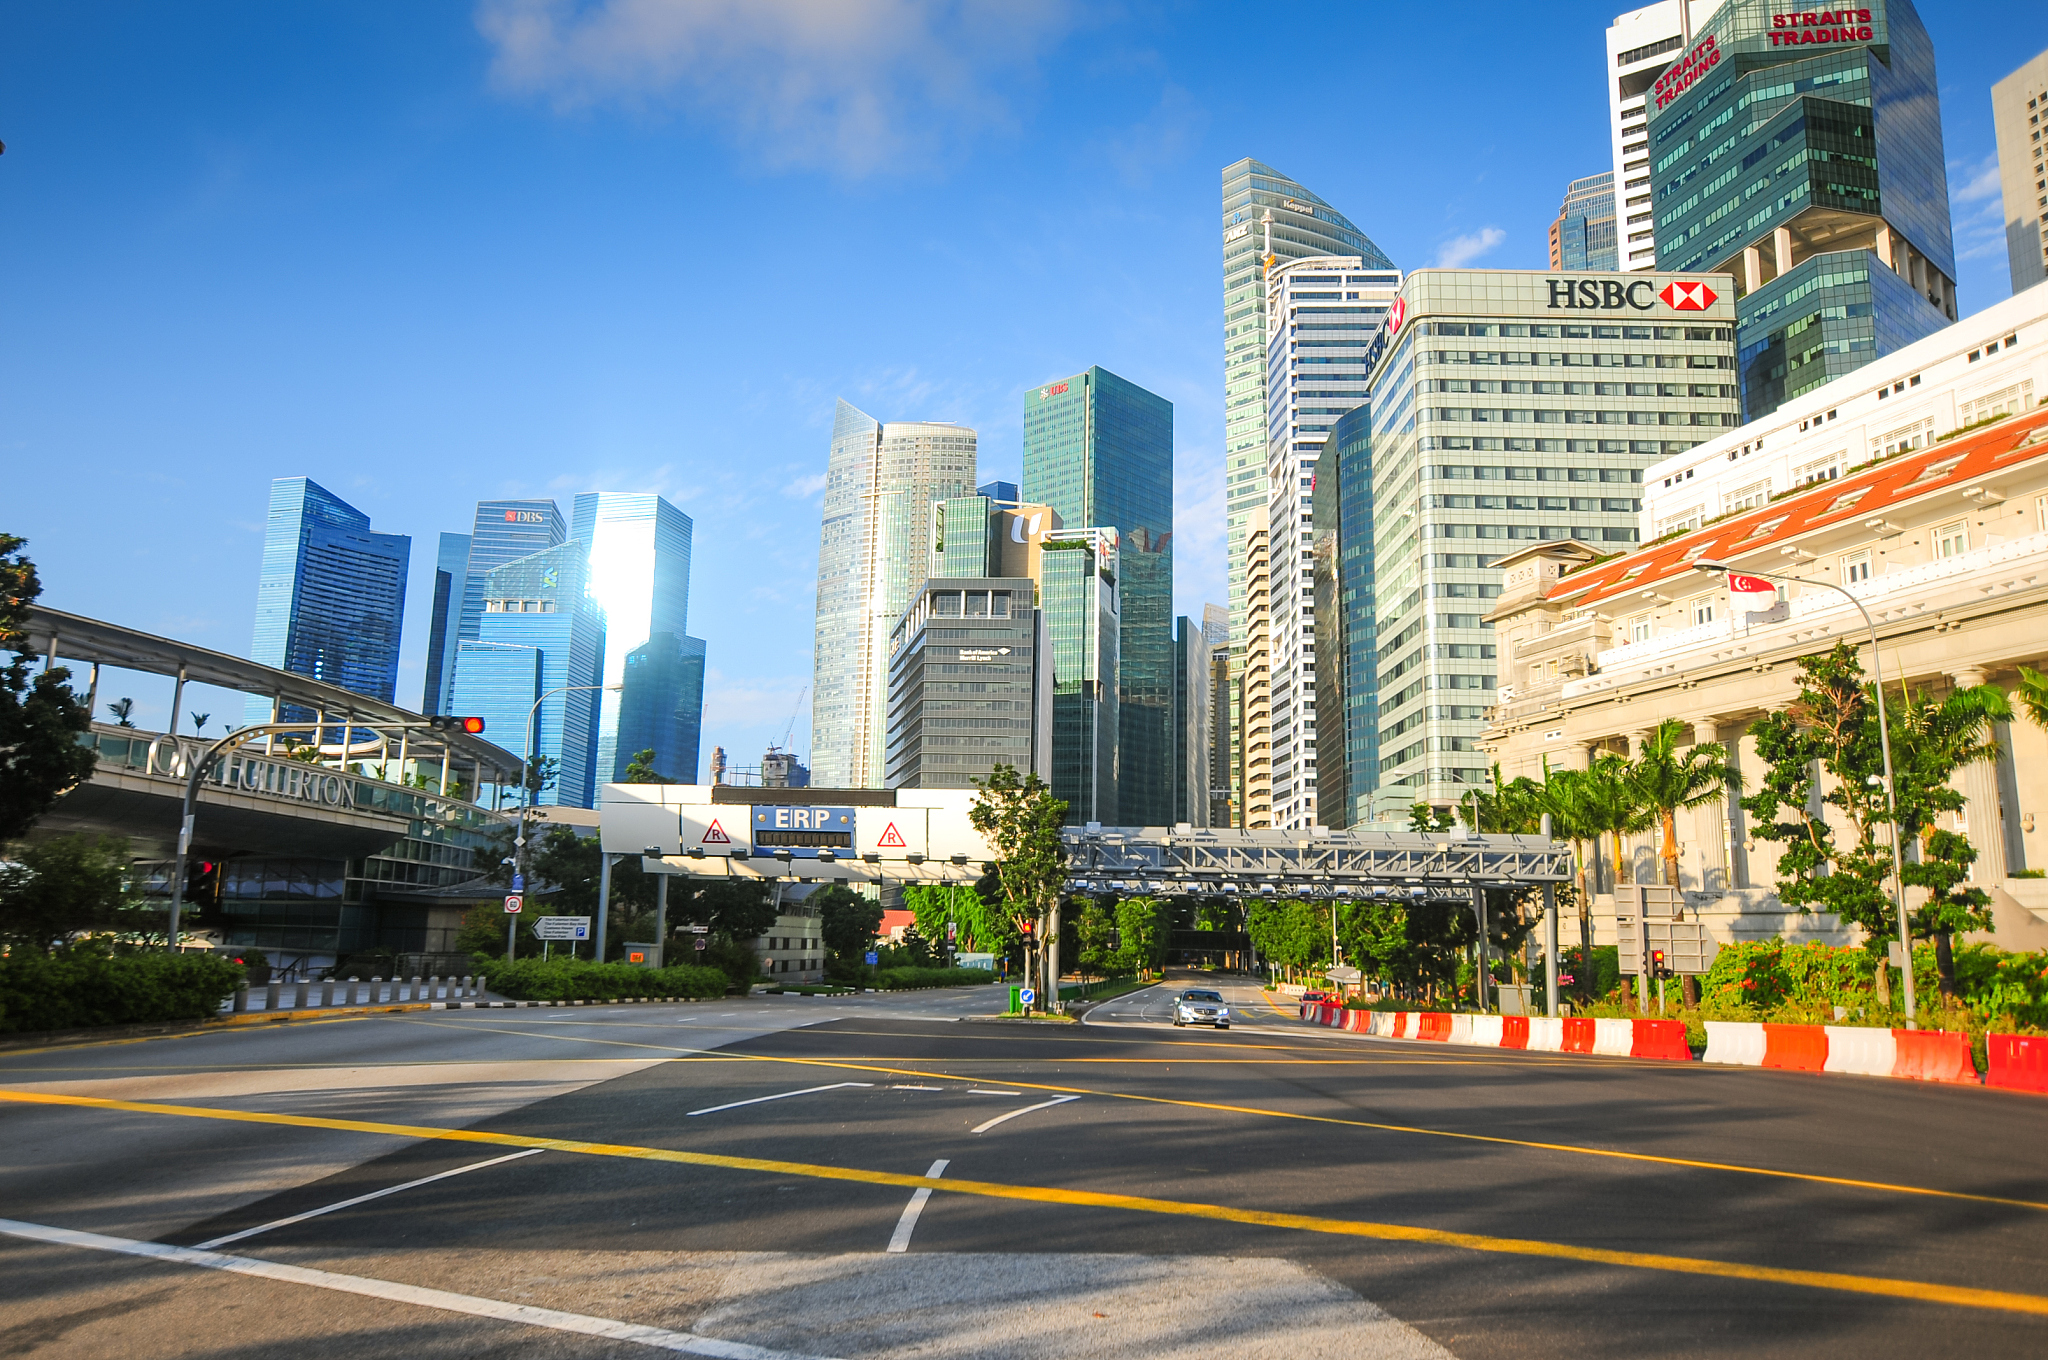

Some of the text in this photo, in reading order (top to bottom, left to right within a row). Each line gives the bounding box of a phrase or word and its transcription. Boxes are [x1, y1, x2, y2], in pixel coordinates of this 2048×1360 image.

[1773, 9, 1871, 28] STRAITS
[1768, 26, 1873, 46] TRADING
[1655, 35, 1715, 95] STRAITS
[1656, 48, 1720, 110] TRADING
[1283, 199, 1313, 214] Keppel
[1225, 226, 1248, 244] ANZ
[1546, 279, 1655, 310] HSBC
[1365, 317, 1389, 380] HSBC
[1050, 383, 1068, 396] UBS
[517, 511, 543, 523] DBS
[775, 809, 830, 828] ERP
[888, 832, 896, 843] R
